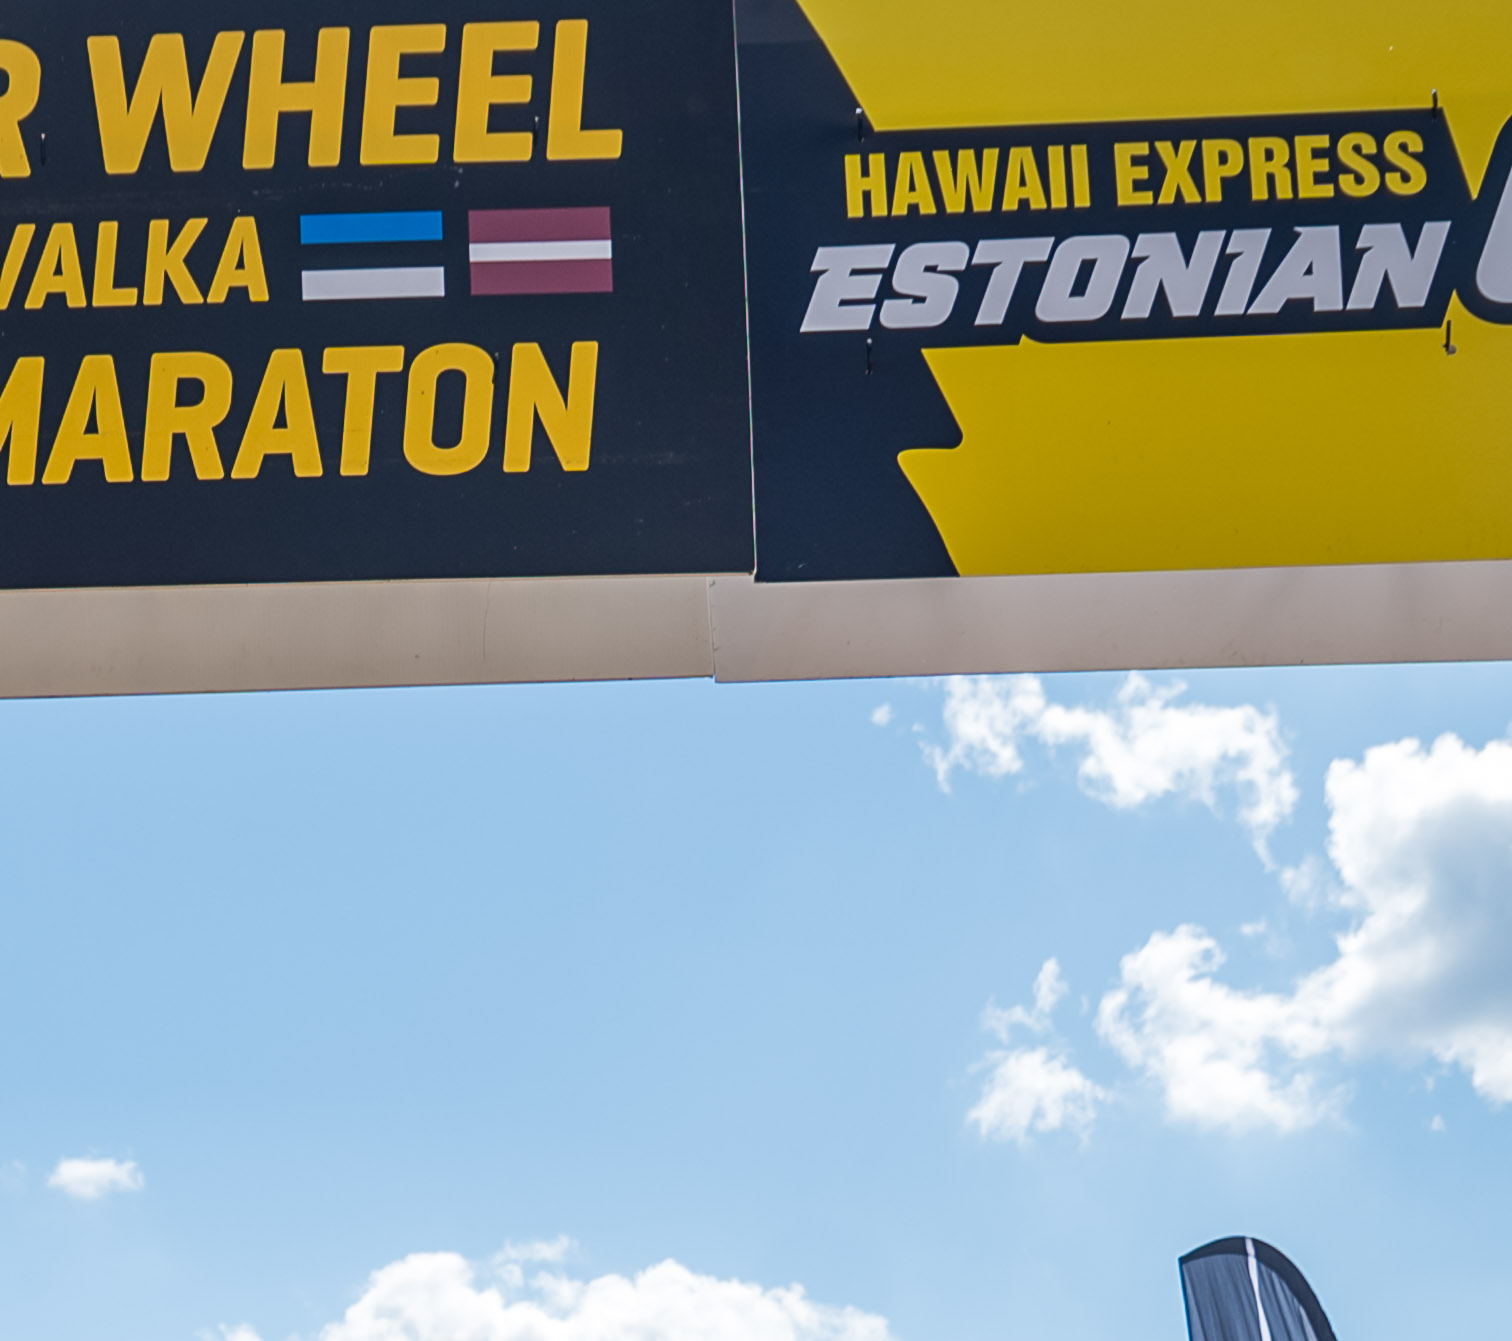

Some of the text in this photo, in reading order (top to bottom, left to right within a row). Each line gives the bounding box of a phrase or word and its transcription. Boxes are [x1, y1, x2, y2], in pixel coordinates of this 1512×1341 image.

[87, 18, 623, 174] WHEEL
[843, 130, 1428, 219] HAWAII EXPRESS
[800, 220, 1451, 334] ESTONIAN
